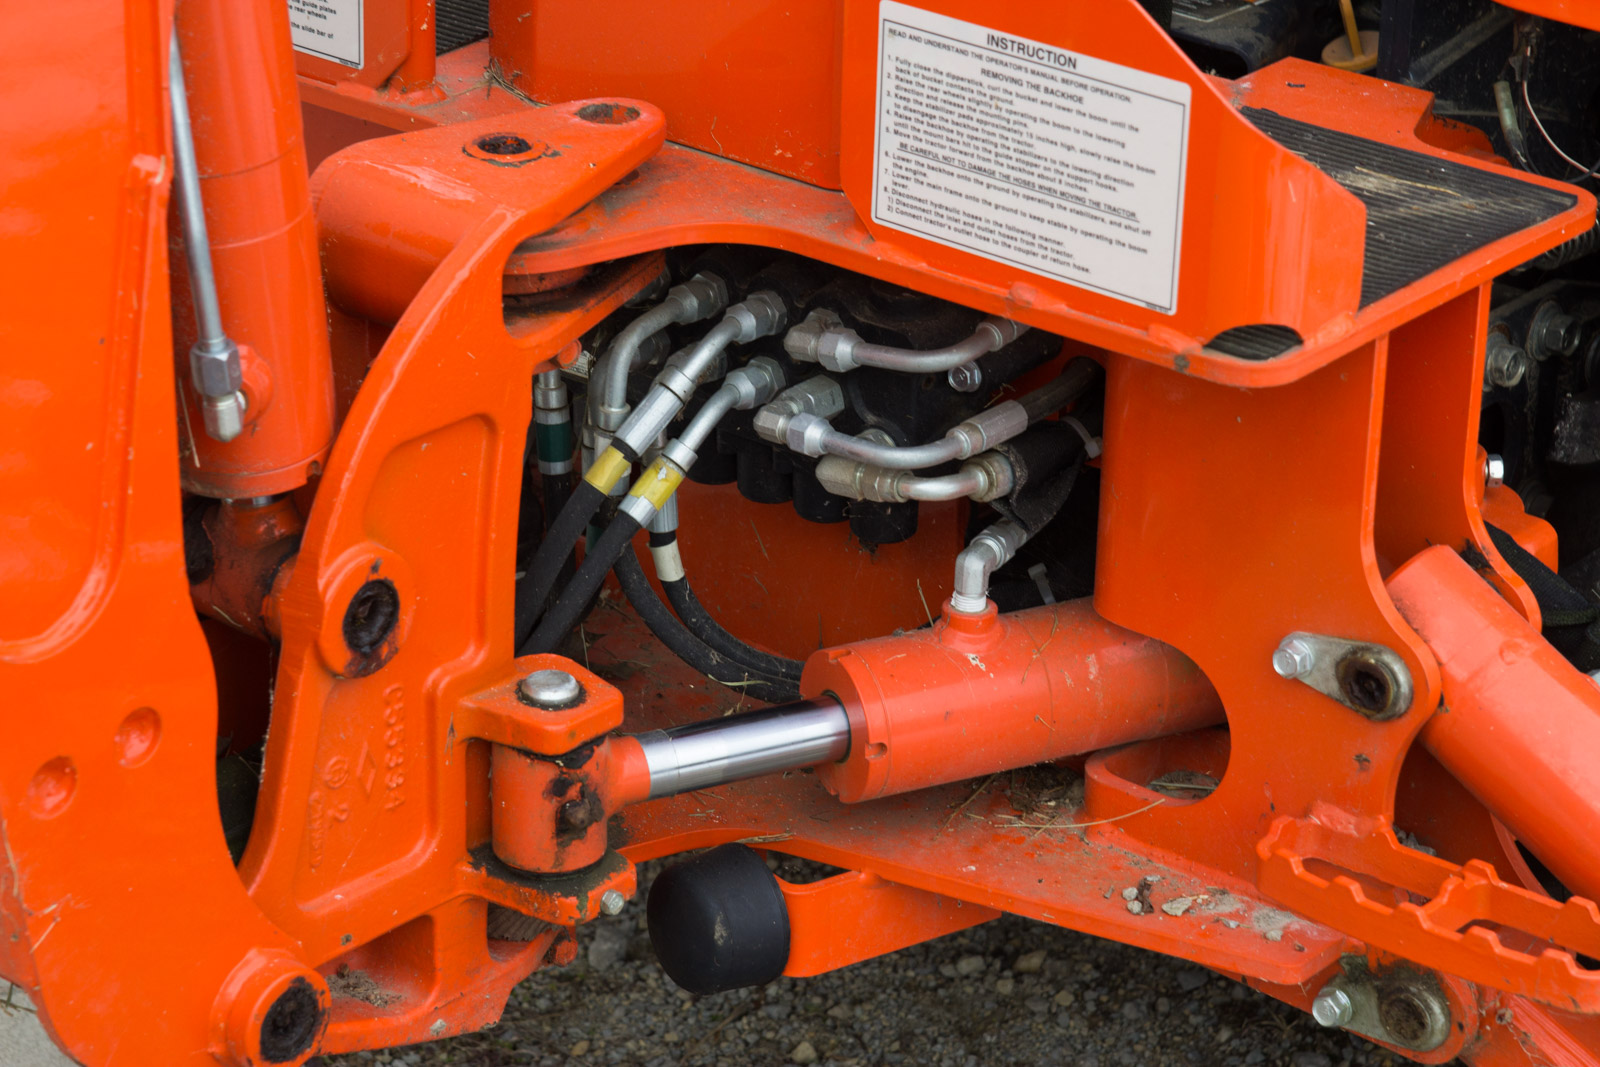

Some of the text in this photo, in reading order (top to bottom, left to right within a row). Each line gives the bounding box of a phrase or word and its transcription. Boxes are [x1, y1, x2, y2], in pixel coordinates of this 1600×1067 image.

[302, 0, 318, 9] guide
[320, 6, 336, 14] plates
[302, 26, 315, 34] slide
[307, 10, 327, 20] wheels
[888, 28, 1131, 102] READ AND UNDERSTAND THE OPERATOR'S MANUAL BEFORE OPERATION.
[986, 33, 1077, 70] INSTRUCTION
[894, 74, 913, 85] Raise
[942, 90, 965, 100] wheels
[967, 97, 992, 109] slightly
[1004, 108, 1037, 123] operating
[1052, 120, 1071, 131] boom
[1094, 134, 1125, 148] lowering
[895, 66, 911, 75] back
[921, 73, 943, 84] bucket
[945, 81, 974, 94] contacts
[988, 94, 1014, 105] ground.
[895, 56, 911, 67] Fully
[913, 63, 930, 72] close
[945, 72, 984, 88] dipperstick,
[1015, 92, 1037, 103] bucket
[1054, 103, 1073, 112] lower
[1088, 112, 1107, 123] boom
[1110, 120, 1125, 128] until
[895, 84, 923, 97] direction
[940, 98, 963, 109] release
[979, 109, 1010, 124] mounting
[1012, 119, 1028, 128] pins.
[980, 68, 1083, 103] REMOVING THE BACKHOE
[894, 92, 910, 103] Keep
[925, 103, 955, 115] stabilizer
[957, 112, 973, 121] pads
[976, 118, 1023, 136] approximately
[1035, 135, 1057, 146] inches
[1060, 141, 1076, 152] high,
[1079, 148, 1101, 160] slowly
[1103, 156, 1120, 164] raise
[1135, 164, 1155, 174] boom
[902, 105, 936, 120] disengage
[950, 119, 979, 132] backhoe
[980, 128, 996, 137] from
[1010, 137, 1035, 148] tractor.
[893, 128, 910, 138] Move
[925, 138, 946, 149] tractor
[949, 145, 974, 158] forward
[976, 153, 991, 163] from
[1006, 163, 1034, 176] backhoe
[1037, 173, 1055, 182] about
[1064, 181, 1088, 192] inches.
[894, 121, 908, 129] until
[923, 130, 943, 140] mount
[945, 136, 960, 144] bars
[994, 151, 1012, 160] guide
[1015, 157, 1040, 168] stopper
[1066, 173, 1092, 184] support
[1095, 180, 1117, 191] hooks.
[899, 141, 1136, 219] BE CAREFUL NOT TO DAMAGE THE HOSES WHEN MOVING THE TRACTOR.
[904, 167, 928, 177] engine.
[891, 180, 909, 188] lever.
[891, 188, 927, 204] Disconnect
[930, 200, 959, 214] hydraulic
[962, 210, 981, 221] hoses
[1005, 224, 1035, 239] following
[1038, 235, 1064, 246] manner.
[895, 198, 932, 214] Disconnect
[946, 215, 960, 224] inlet
[976, 225, 995, 235] outlet
[997, 231, 1017, 241] hoses
[1020, 237, 1035, 247] from
[1050, 247, 1074, 258] tractor.
[895, 207, 921, 220] Connect
[924, 217, 951, 230] tractor's
[953, 227, 972, 236] outlet
[974, 232, 990, 242] hose
[1013, 245, 1038, 257] coupler
[1049, 257, 1070, 266] return
[1072, 263, 1090, 272] hose.
